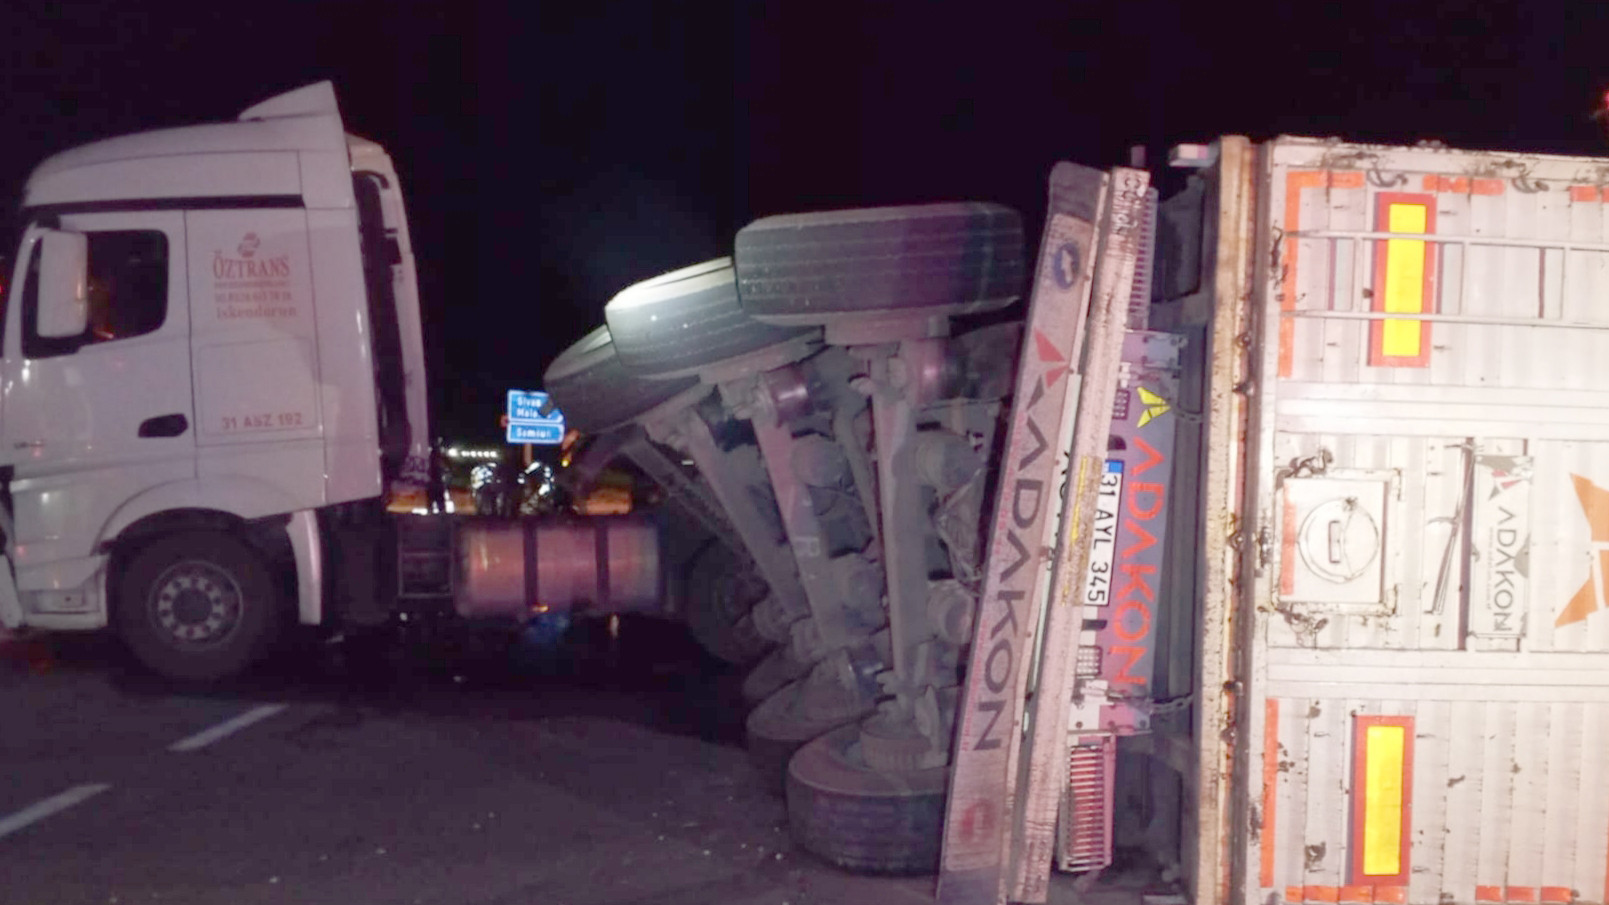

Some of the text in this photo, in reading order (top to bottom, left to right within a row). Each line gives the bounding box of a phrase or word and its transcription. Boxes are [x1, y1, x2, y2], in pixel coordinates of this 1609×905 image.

[213, 249, 290, 280] ÖZTRANS
[221, 416, 238, 430] 31
[973, 416, 1049, 751] ADAKON
[1087, 475, 1119, 602] 31 AYL 345
[1109, 435, 1165, 685] ADAKON
[1493, 506, 1517, 632] ADAKON
